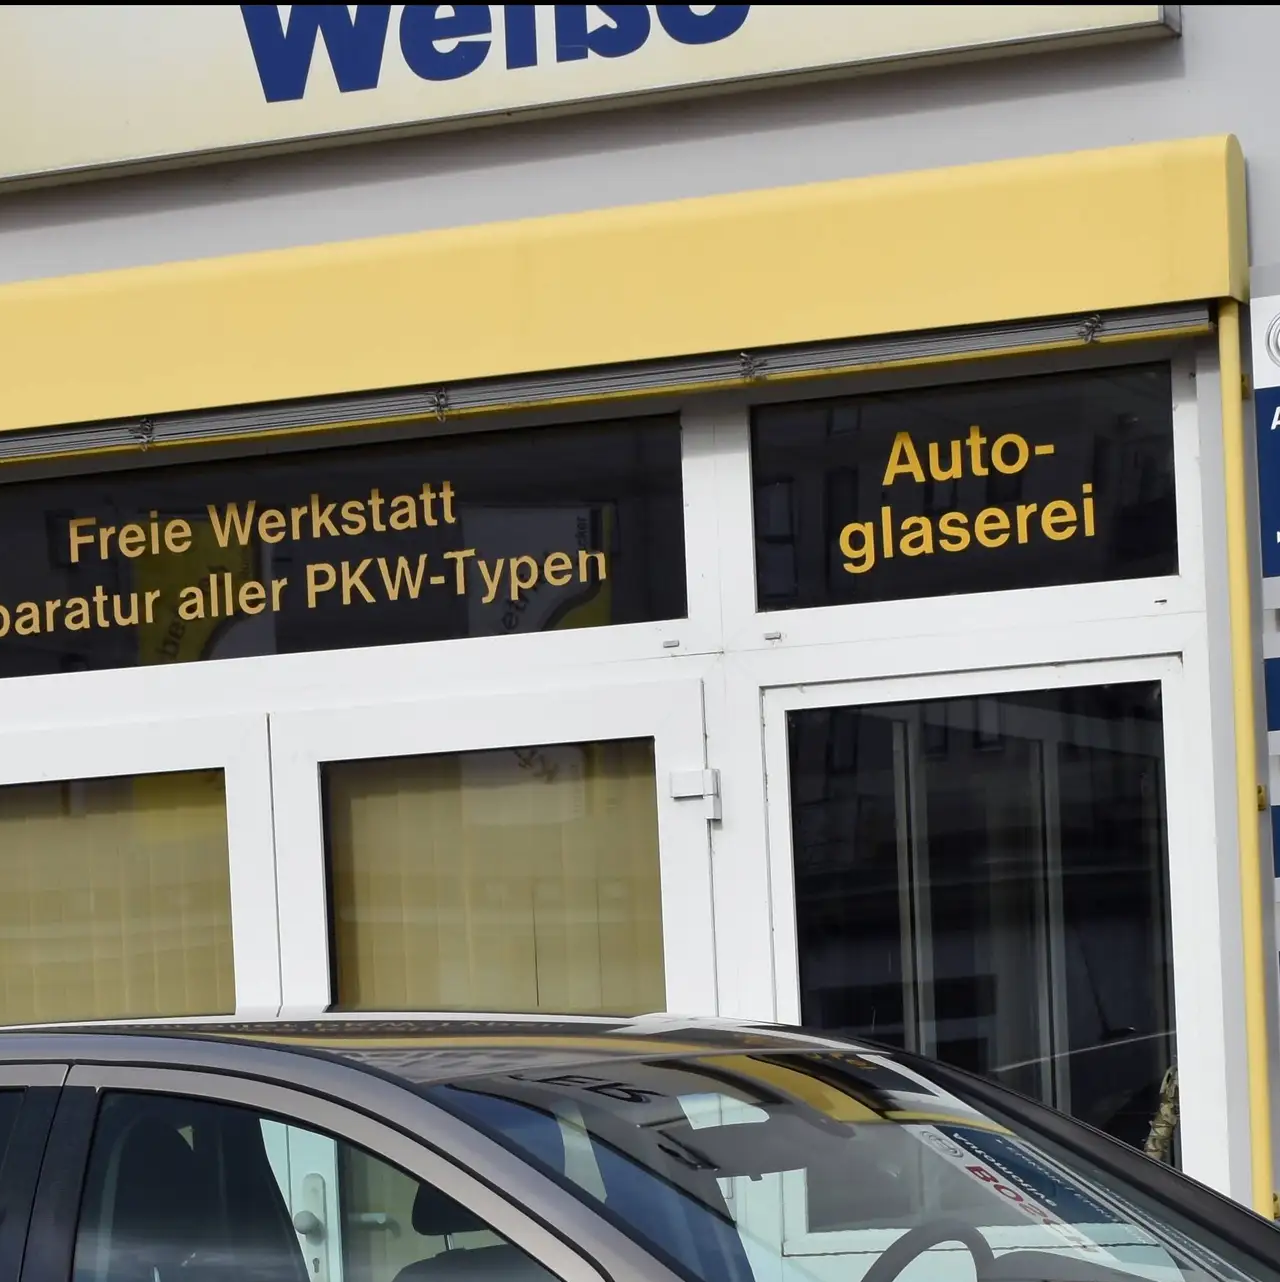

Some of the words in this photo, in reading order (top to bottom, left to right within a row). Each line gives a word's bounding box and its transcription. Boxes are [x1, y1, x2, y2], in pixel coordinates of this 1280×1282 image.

[882, 426, 1054, 485] Auto-
[70, 510, 193, 564] Freie
[207, 481, 456, 548] Werkstatt
[839, 483, 1095, 574] glaserei
[178, 572, 288, 621] aller
[306, 548, 607, 609] PKW-Typen
